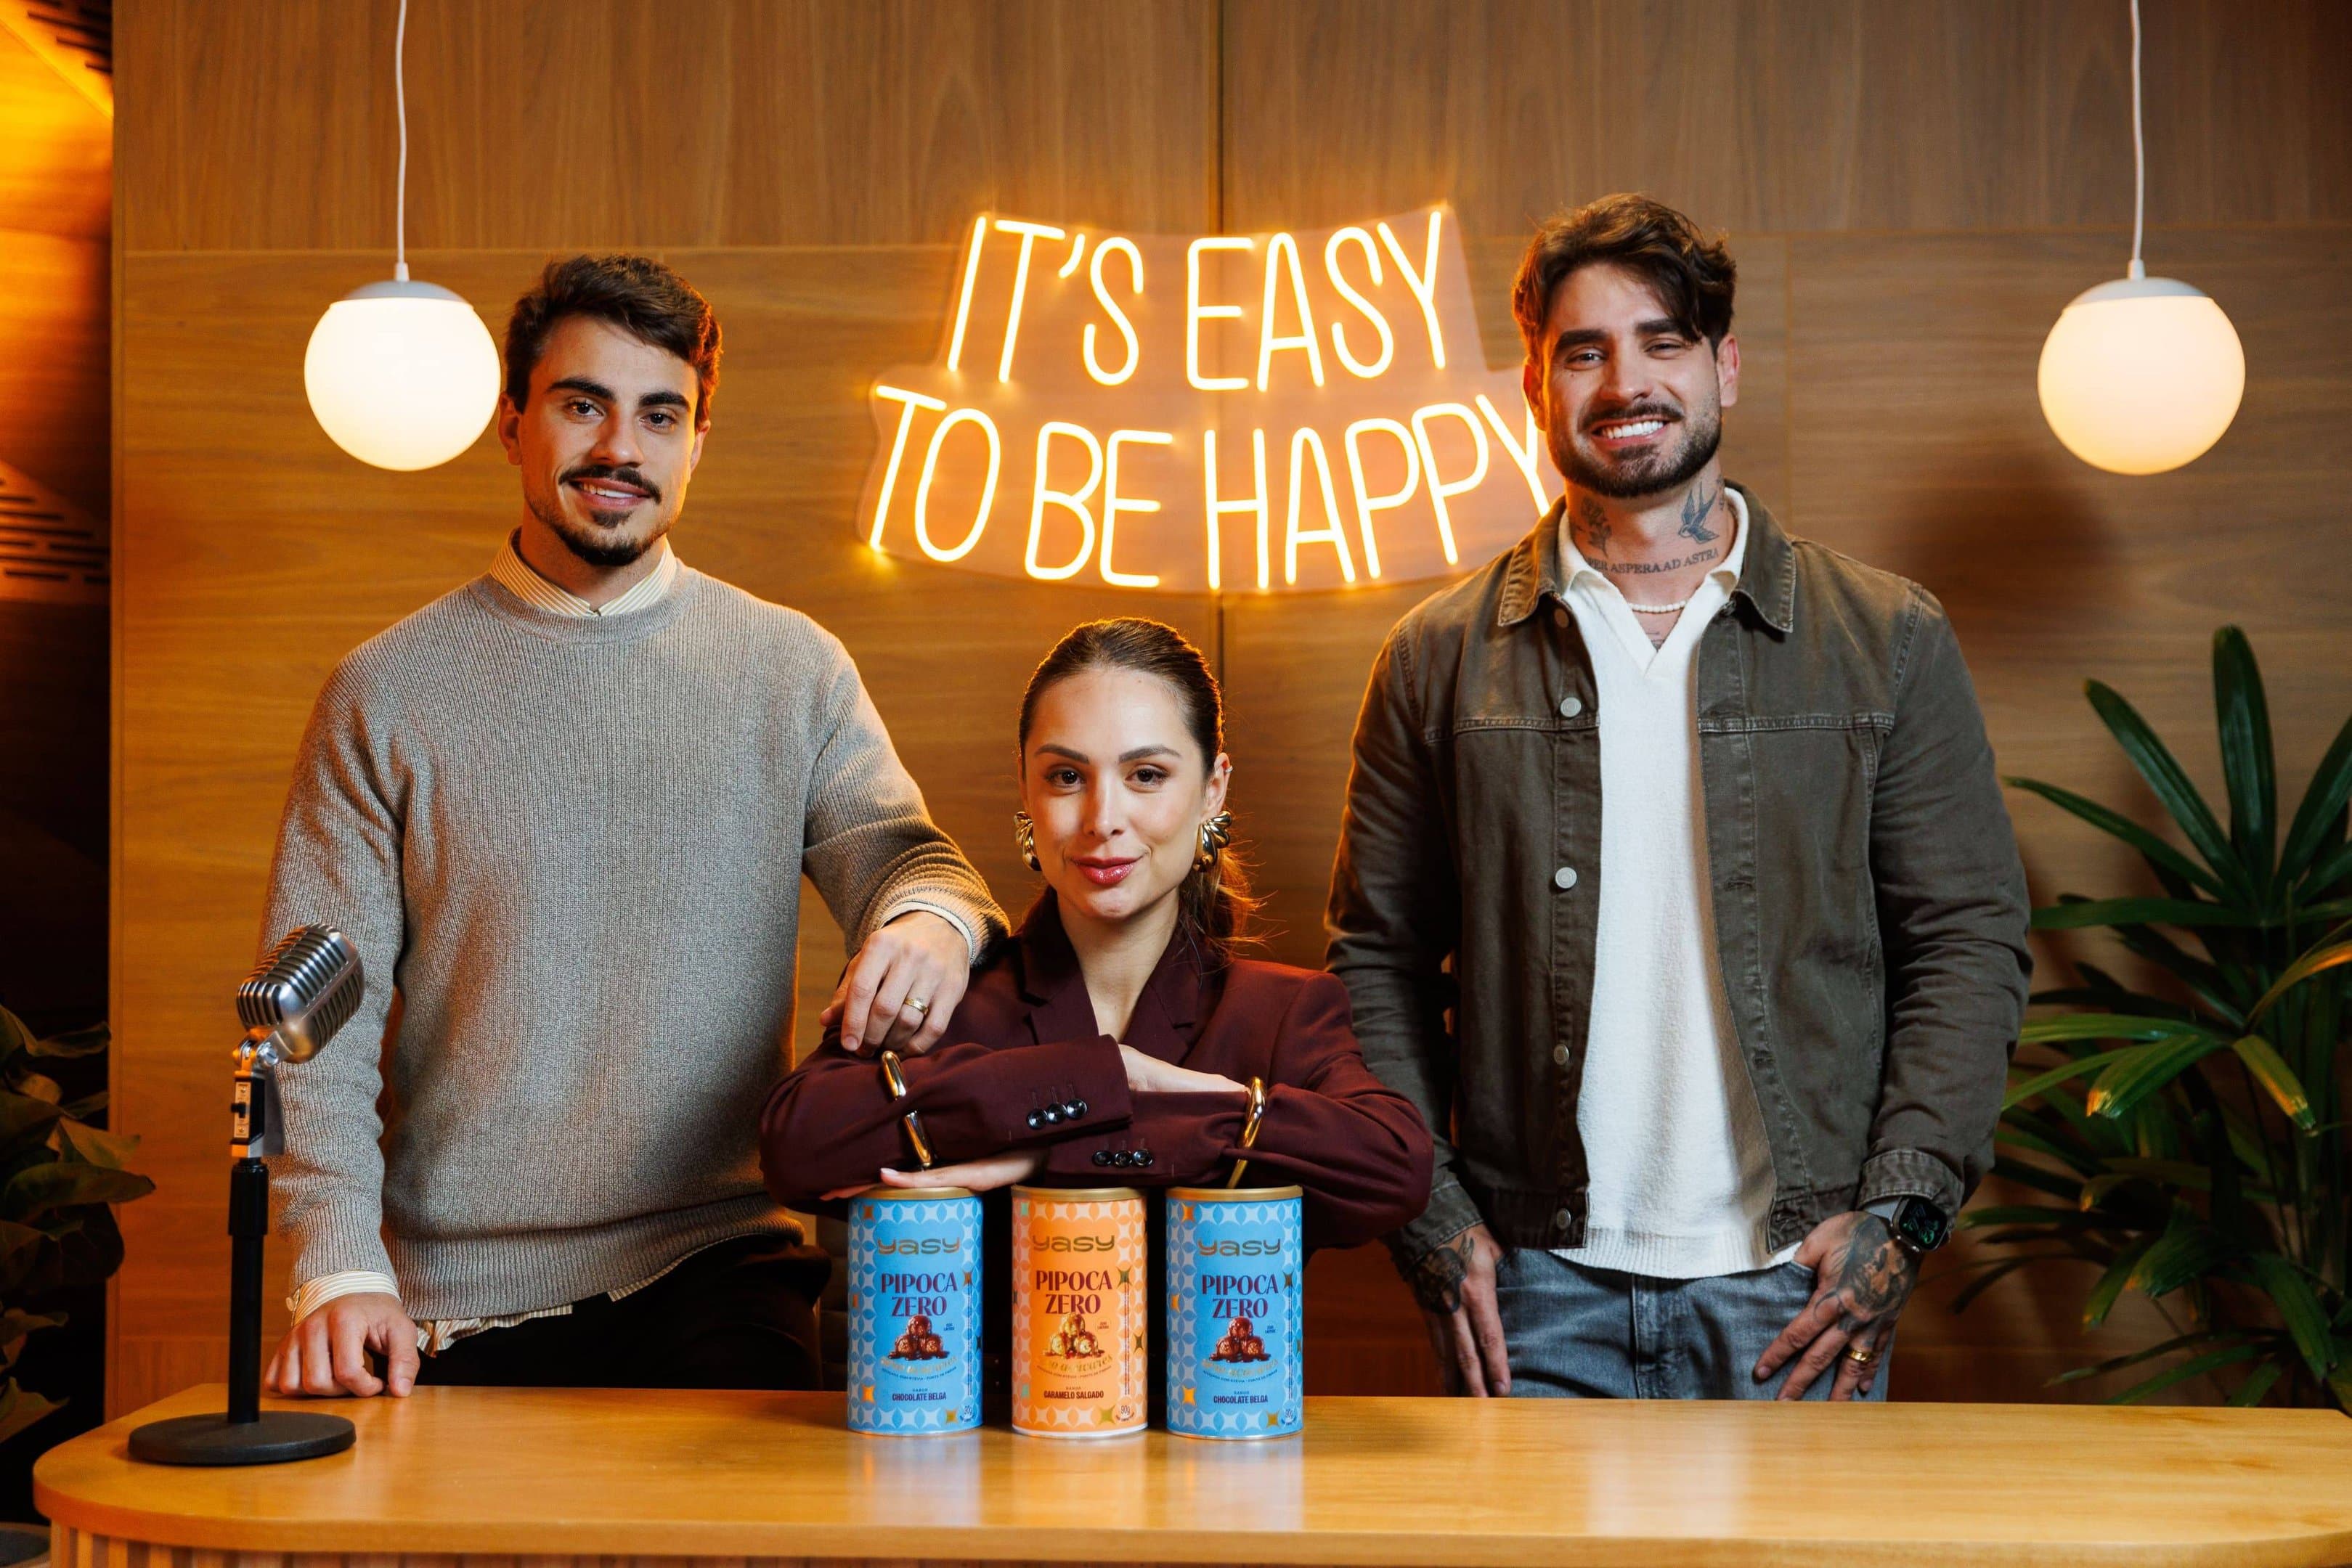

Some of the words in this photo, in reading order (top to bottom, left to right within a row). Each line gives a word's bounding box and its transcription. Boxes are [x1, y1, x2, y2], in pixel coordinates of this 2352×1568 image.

[947, 214, 1145, 388] IT'S
[1184, 210, 1447, 393] EASY
[870, 383, 1001, 564] TO
[1024, 420, 1173, 589] BE
[1203, 392, 1551, 592] HAPPY
[1611, 562, 1661, 574] ASPERA
[1662, 559, 1681, 572] AD
[1684, 548, 1719, 566] ASTRA
[876, 1237, 961, 1255] yasy
[1031, 1234, 1115, 1253] yasy
[1197, 1238, 1281, 1257] yasy
[880, 1272, 959, 1294] PIPOCA
[1035, 1270, 1113, 1292] PIPOCA
[1201, 1273, 1279, 1296] PIPOCA
[891, 1295, 948, 1318] ZERO
[1044, 1293, 1102, 1315] ZERO
[1211, 1297, 1269, 1320] ZERO
[892, 1392, 928, 1402] CHOCOLATE
[928, 1391, 947, 1401] BELGA
[1043, 1390, 1075, 1400] CARAMELO
[1075, 1389, 1104, 1399] SALGADO
[1213, 1395, 1249, 1404] CHOCOLATE
[1250, 1395, 1269, 1403] BELGA
